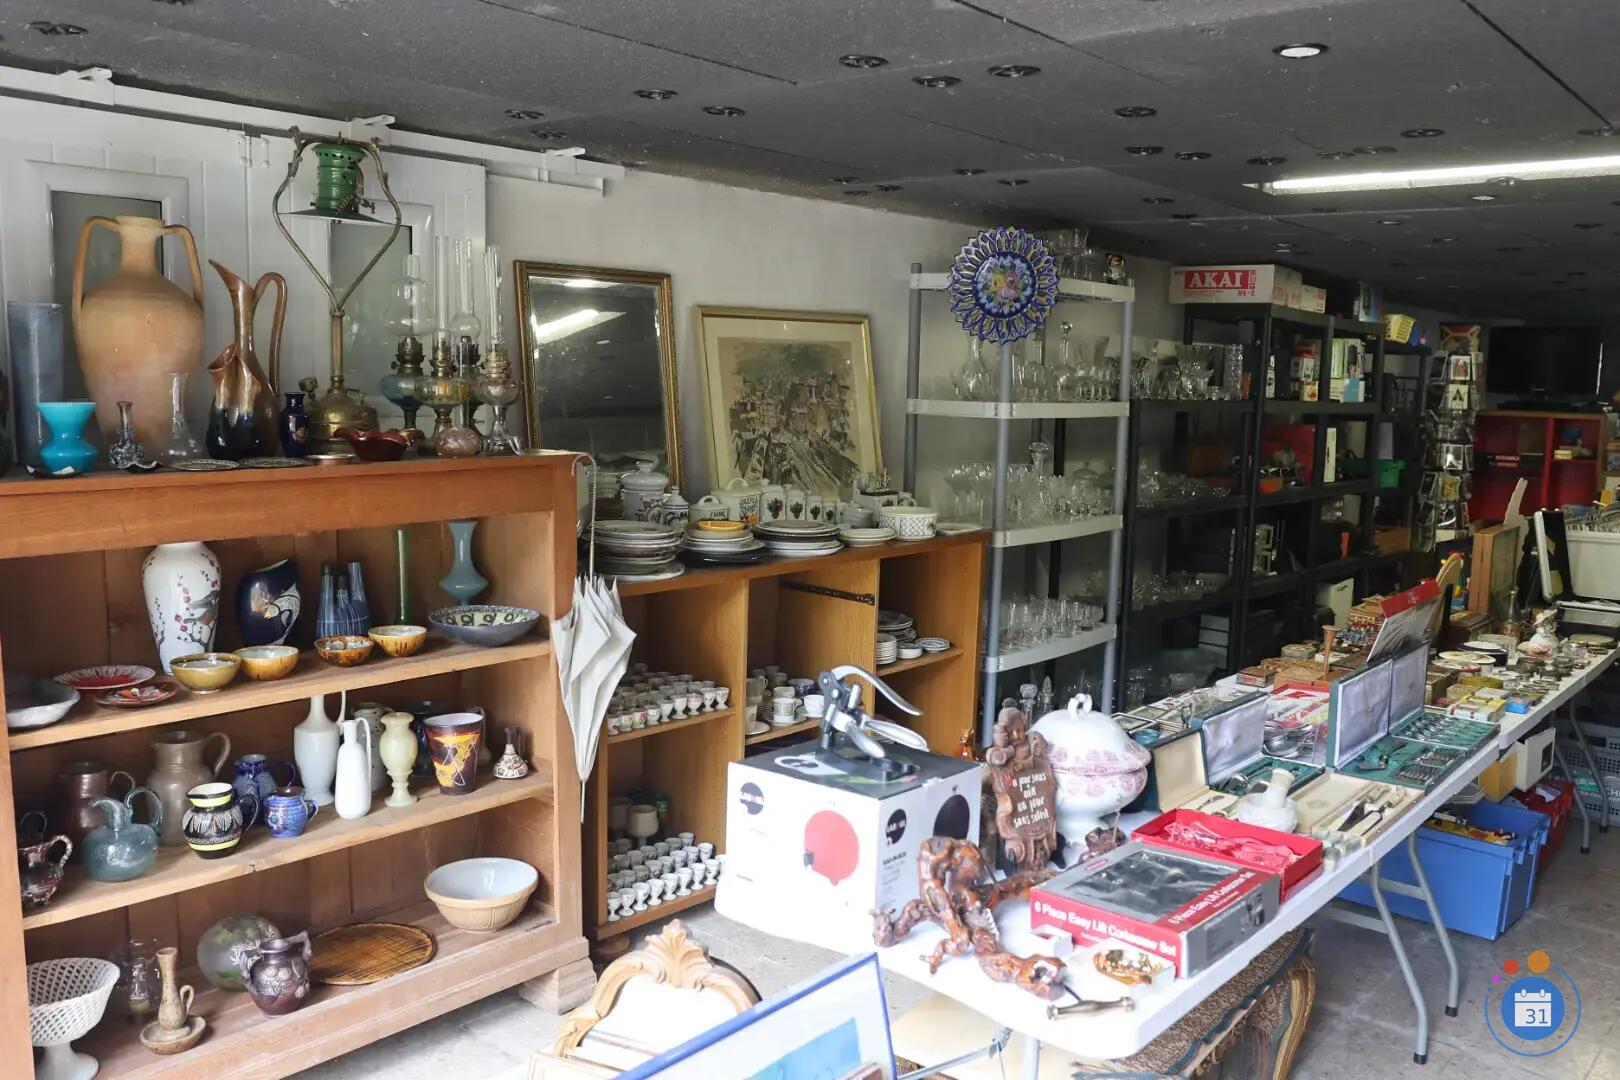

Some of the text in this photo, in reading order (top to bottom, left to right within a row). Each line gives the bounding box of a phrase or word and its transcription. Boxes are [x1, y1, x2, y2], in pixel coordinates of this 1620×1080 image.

[1188, 271, 1243, 288] AKAI
[1017, 796, 1045, 813] un jour
[1068, 911, 1091, 930] Easy
[1159, 940, 1176, 957] Set
